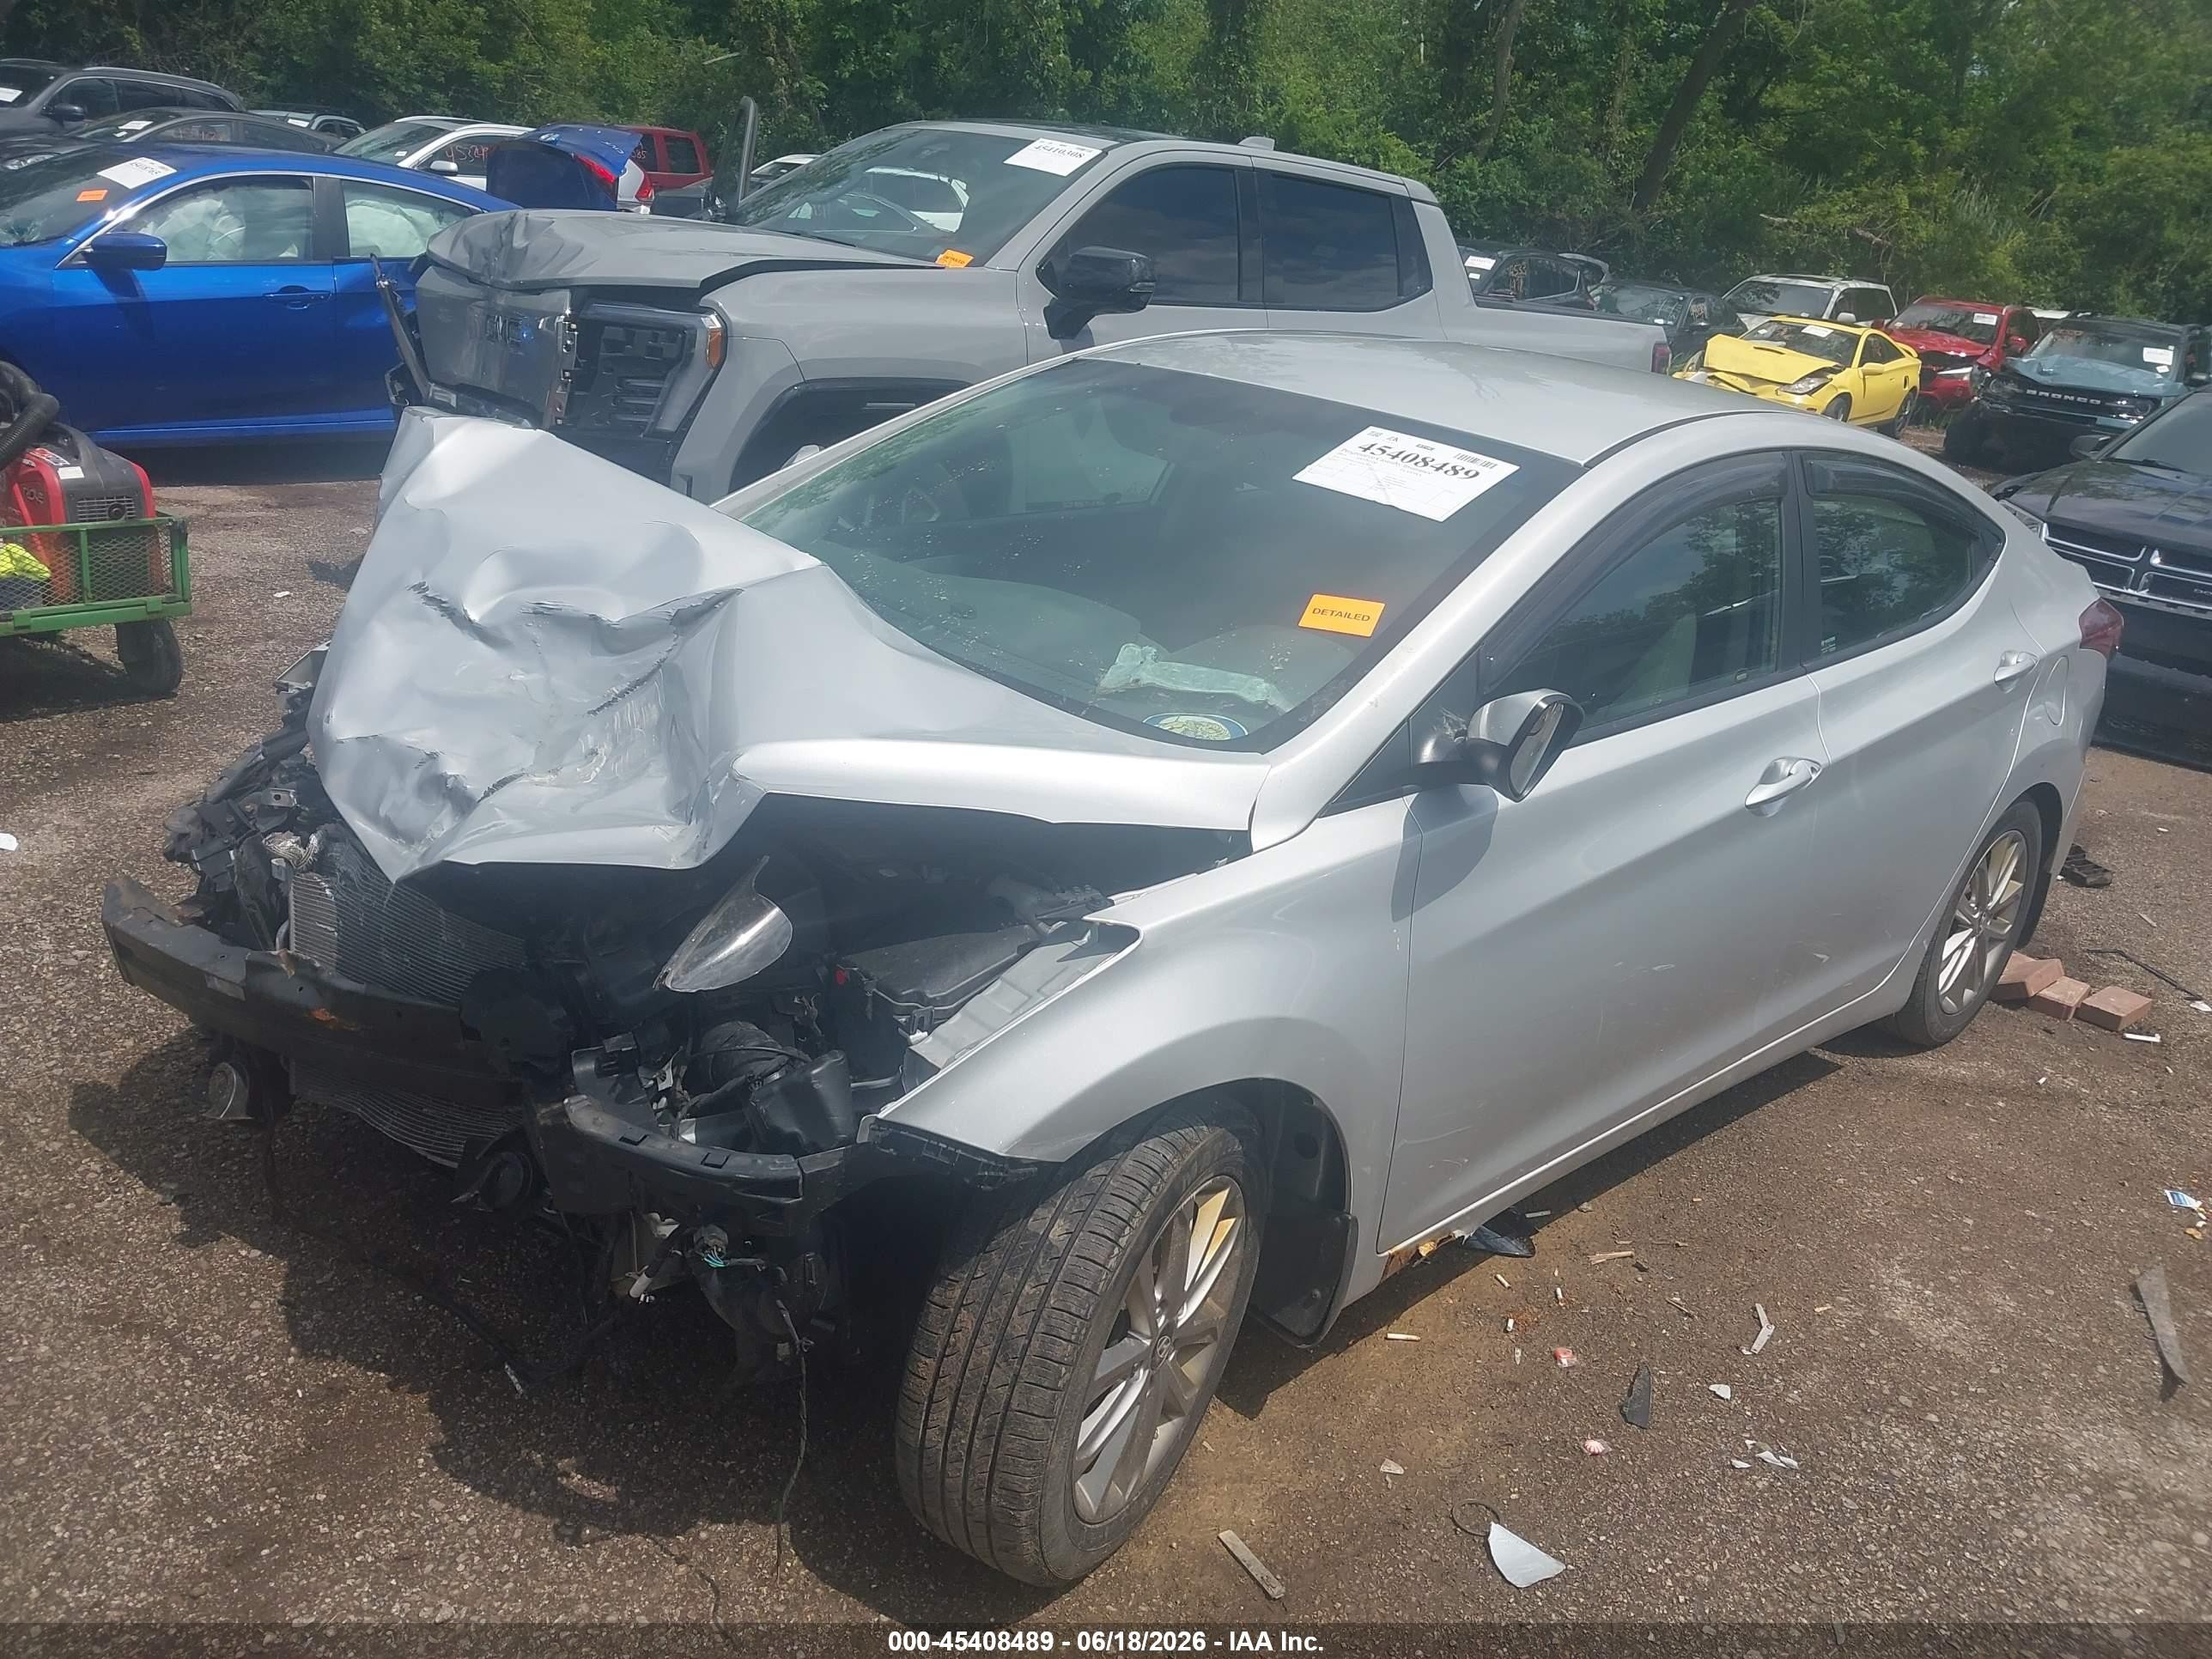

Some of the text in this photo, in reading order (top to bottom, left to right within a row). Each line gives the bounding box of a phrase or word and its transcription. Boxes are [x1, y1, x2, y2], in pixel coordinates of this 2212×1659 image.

[2026, 388, 2102, 405] BRONCO
[1358, 442, 1480, 480] 45408489
[1311, 607, 1371, 622] DETAILED
